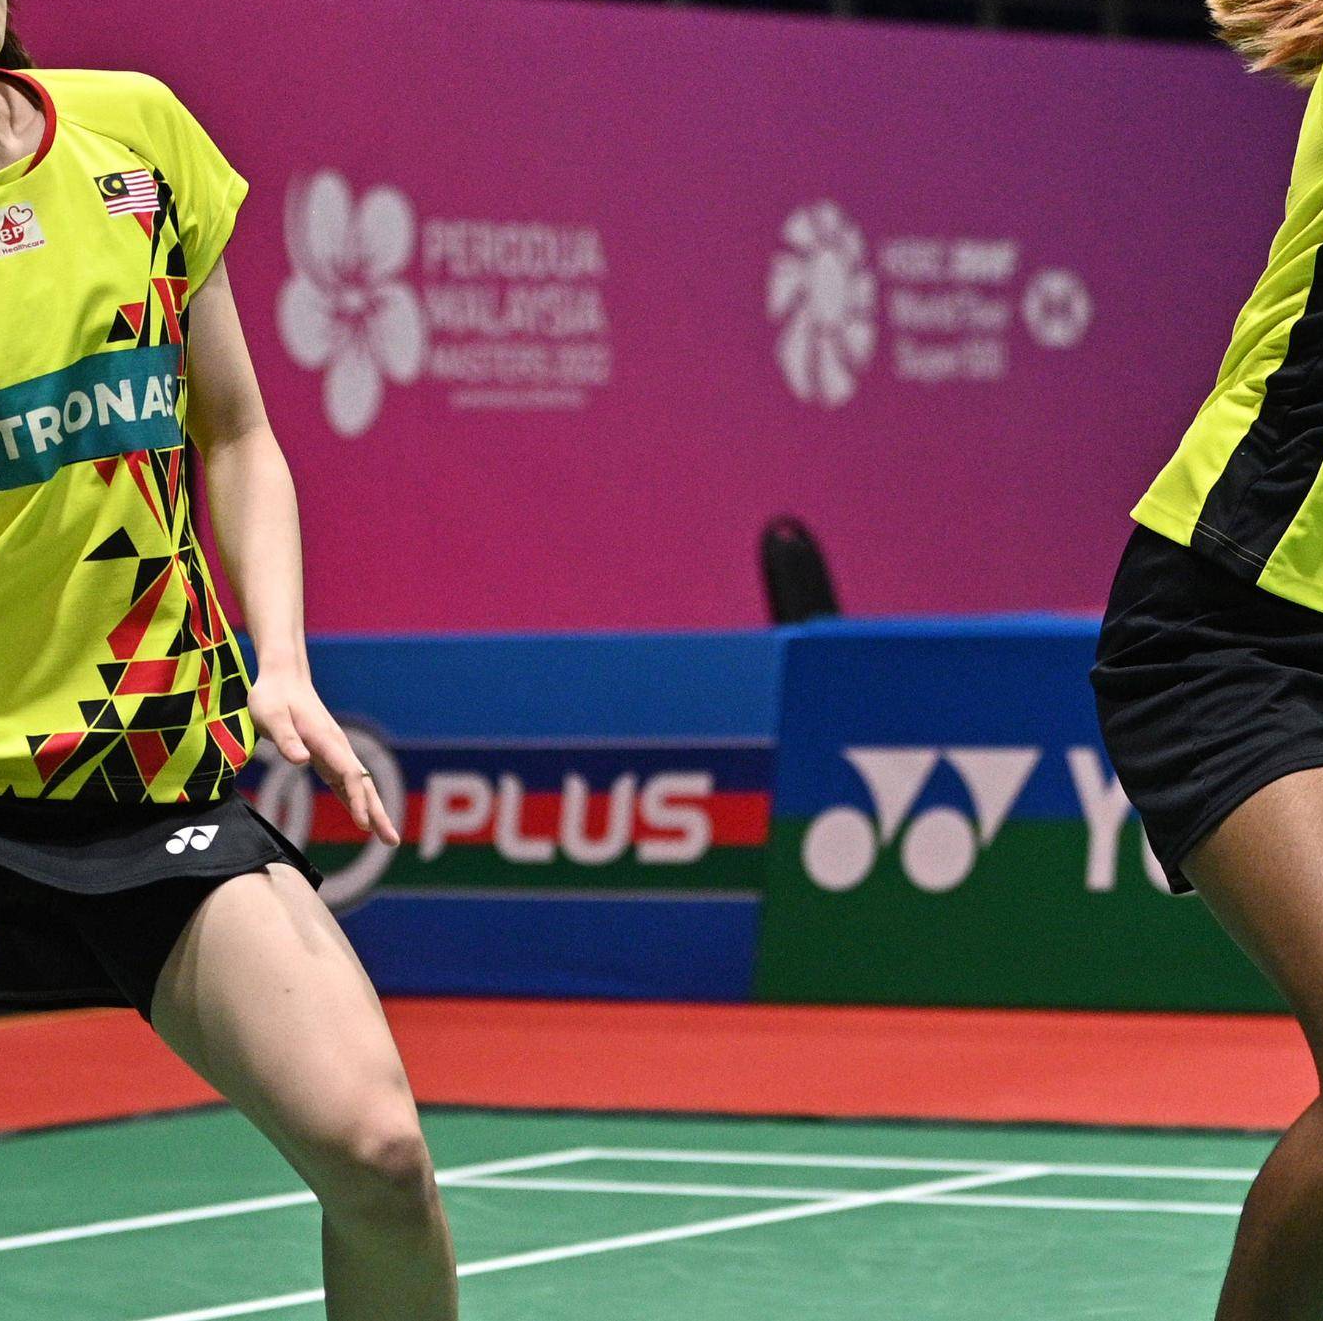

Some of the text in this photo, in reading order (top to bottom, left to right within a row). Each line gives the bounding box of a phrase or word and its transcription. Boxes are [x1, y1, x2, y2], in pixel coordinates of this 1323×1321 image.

[0, 225, 24, 243] BP
[2, 239, 45, 255] Healthcare
[419, 770, 716, 864] PLUS
